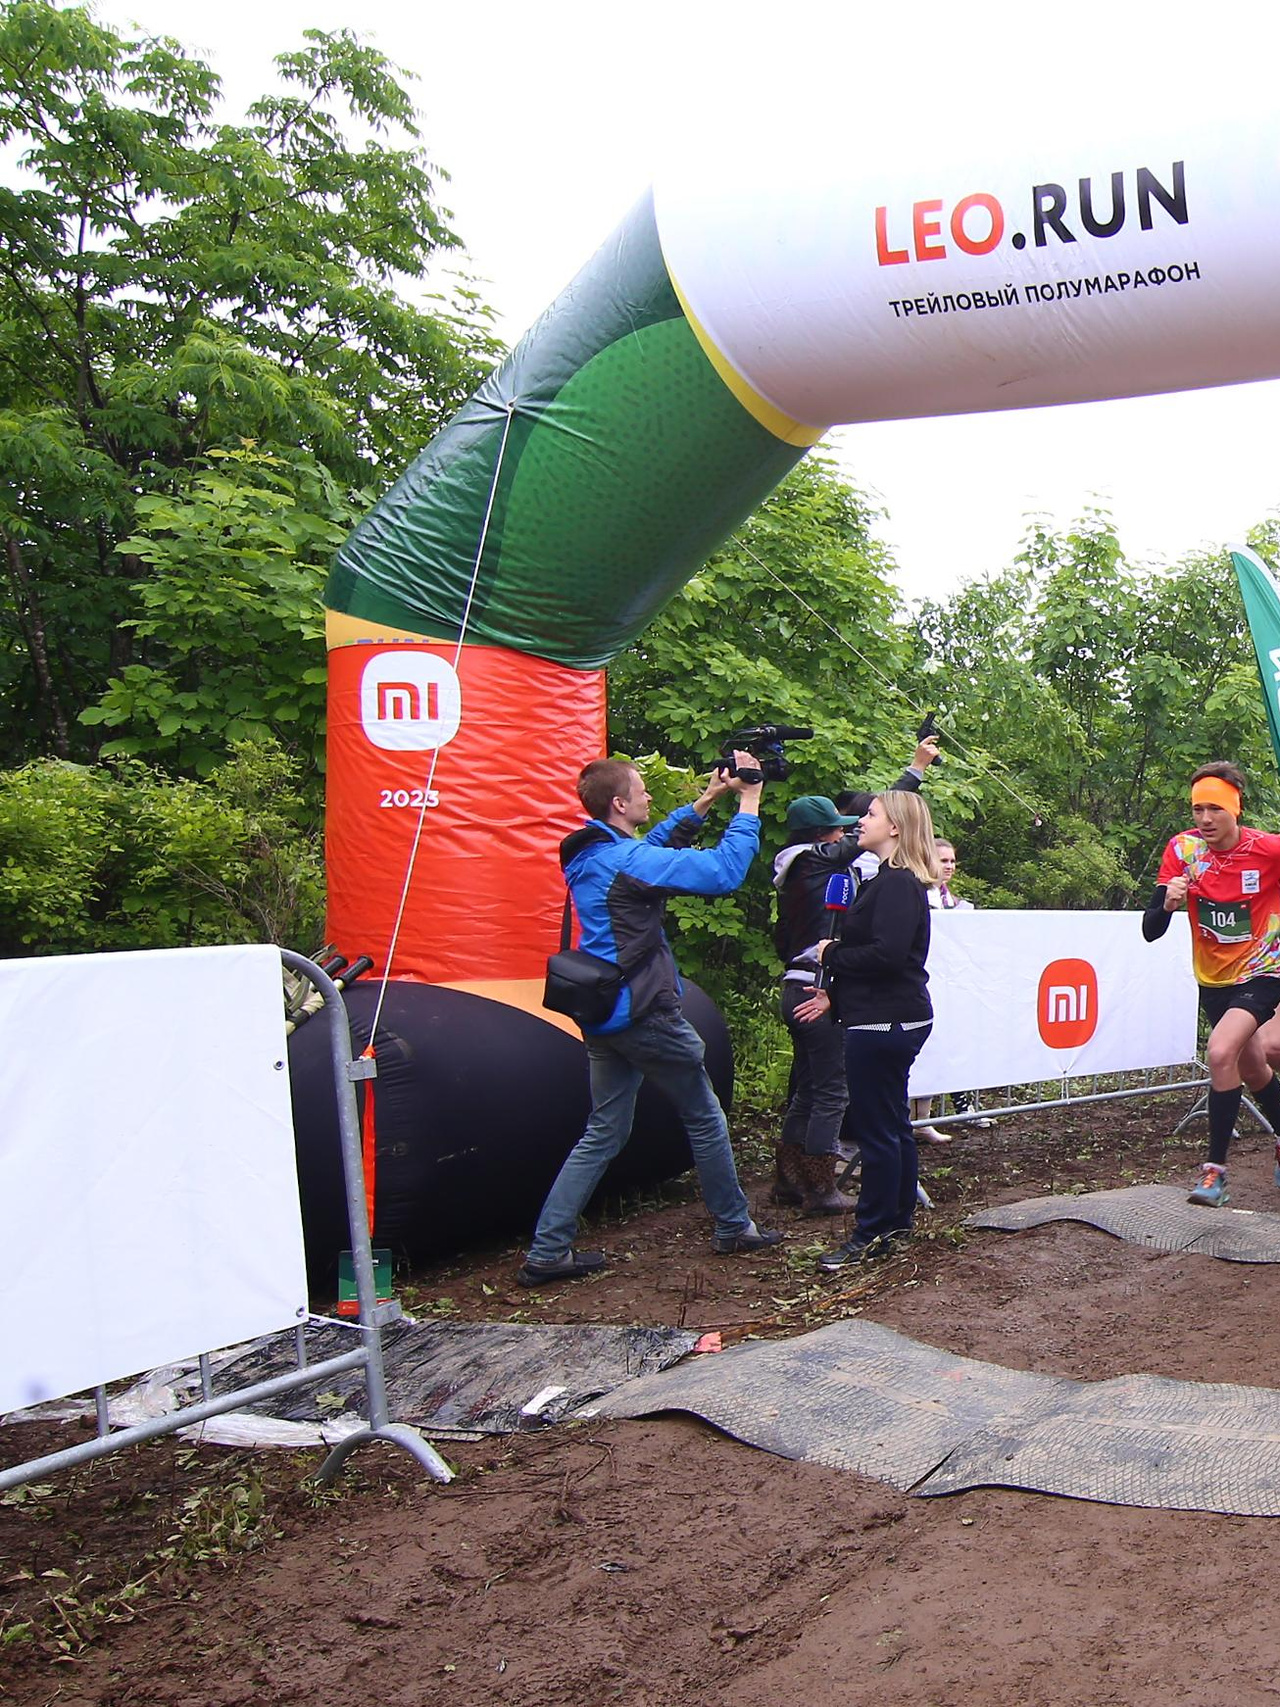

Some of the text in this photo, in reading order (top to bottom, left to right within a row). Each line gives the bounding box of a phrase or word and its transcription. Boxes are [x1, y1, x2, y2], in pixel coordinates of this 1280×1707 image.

[875, 160, 1189, 266] LEO.RUN
[889, 261, 1201, 318] ТРЕЙЛОВЫЙ ПОЛУМАРАФОН
[380, 789, 440, 808] 2023
[1210, 911, 1237, 928] 104
